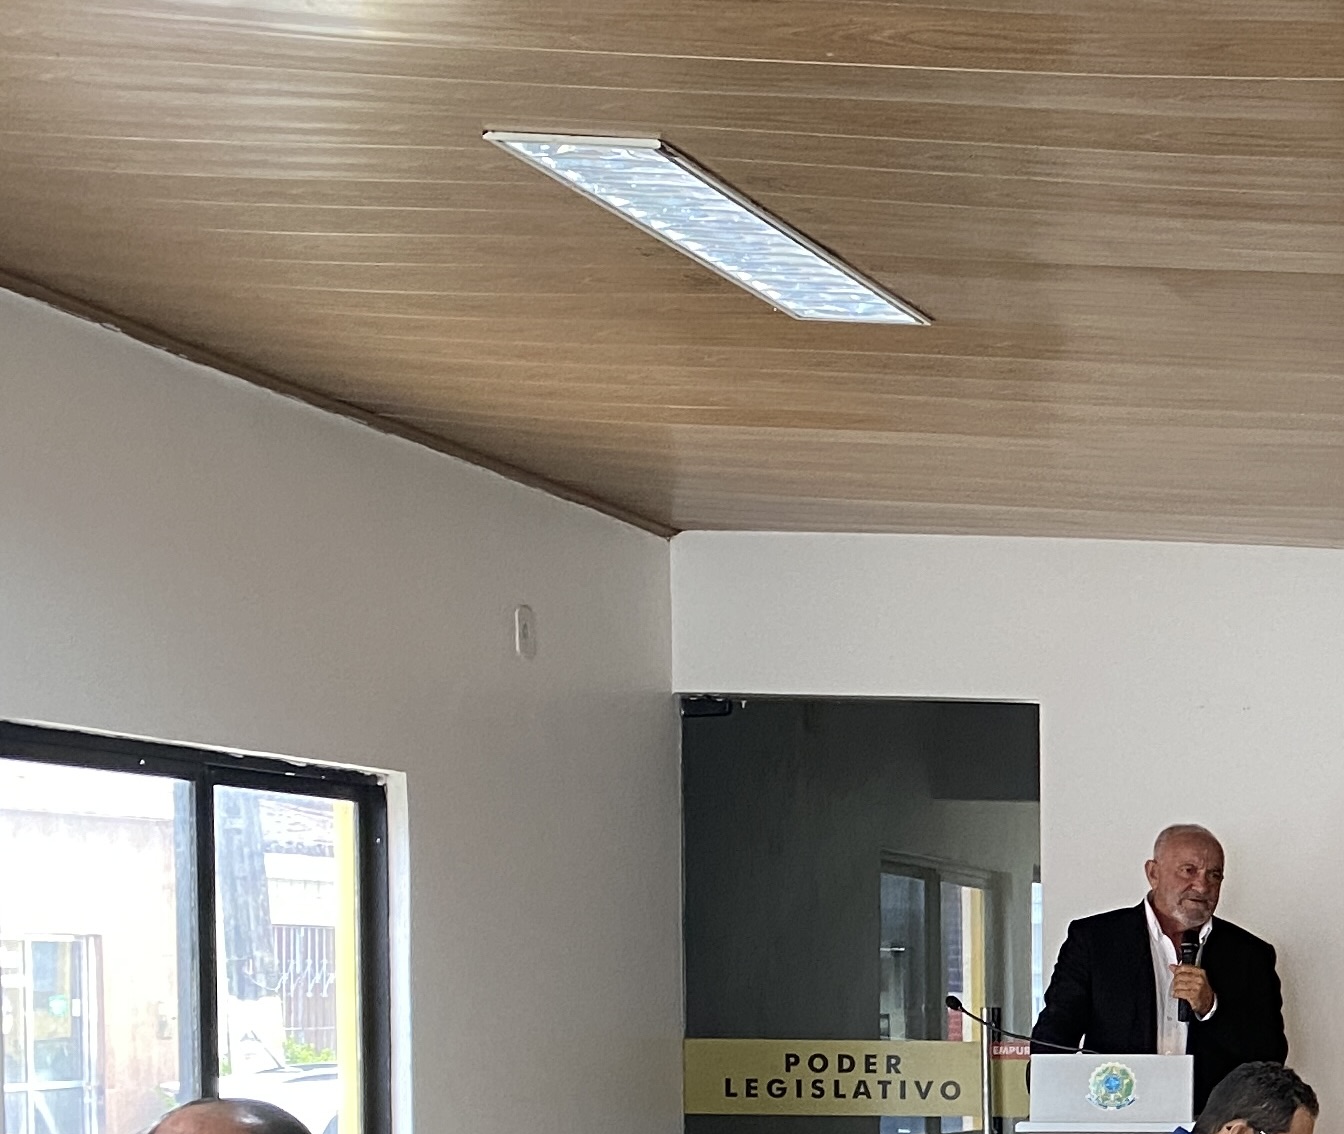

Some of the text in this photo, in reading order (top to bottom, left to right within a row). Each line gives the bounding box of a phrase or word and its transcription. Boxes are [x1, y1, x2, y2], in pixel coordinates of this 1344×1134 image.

[992, 1046, 1031, 1056] EMPUR
[784, 1053, 902, 1075] PODER
[725, 1078, 962, 1100] LEGISLATIVO
